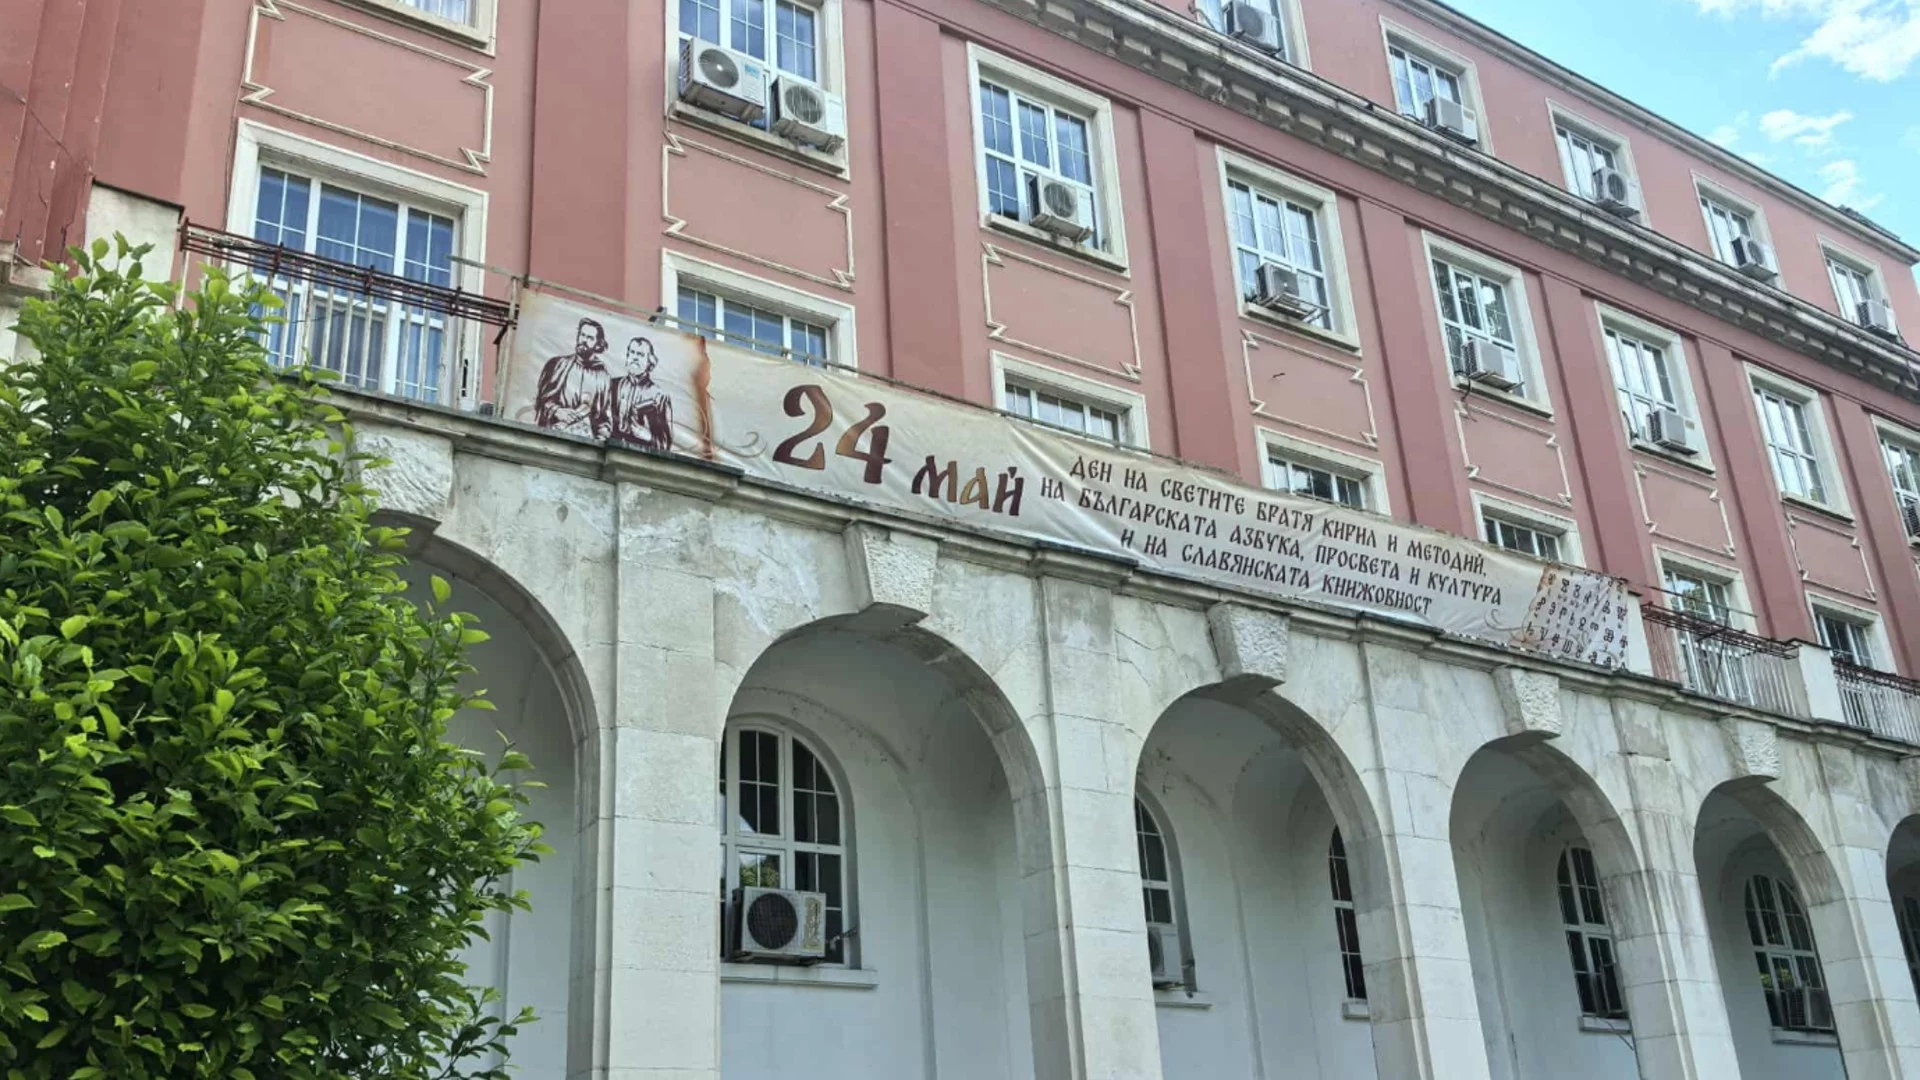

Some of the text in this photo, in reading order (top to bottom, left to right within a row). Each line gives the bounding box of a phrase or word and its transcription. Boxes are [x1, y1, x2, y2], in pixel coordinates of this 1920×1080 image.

[772, 384, 892, 484] 24
[1041, 477, 1502, 606] НА БЪЛГАРСКАТА АЗБУКА, ПРОСВЕТА И КУЛТУРА
[1070, 456, 1487, 577] ДЕН НА СВЕТИТЕ БРАТЯ КИРИЛ И МЕТОДИЙ,
[1120, 528, 1432, 616] И НА СЛАВЯНСКАТА КНИЖОВНОСТ
